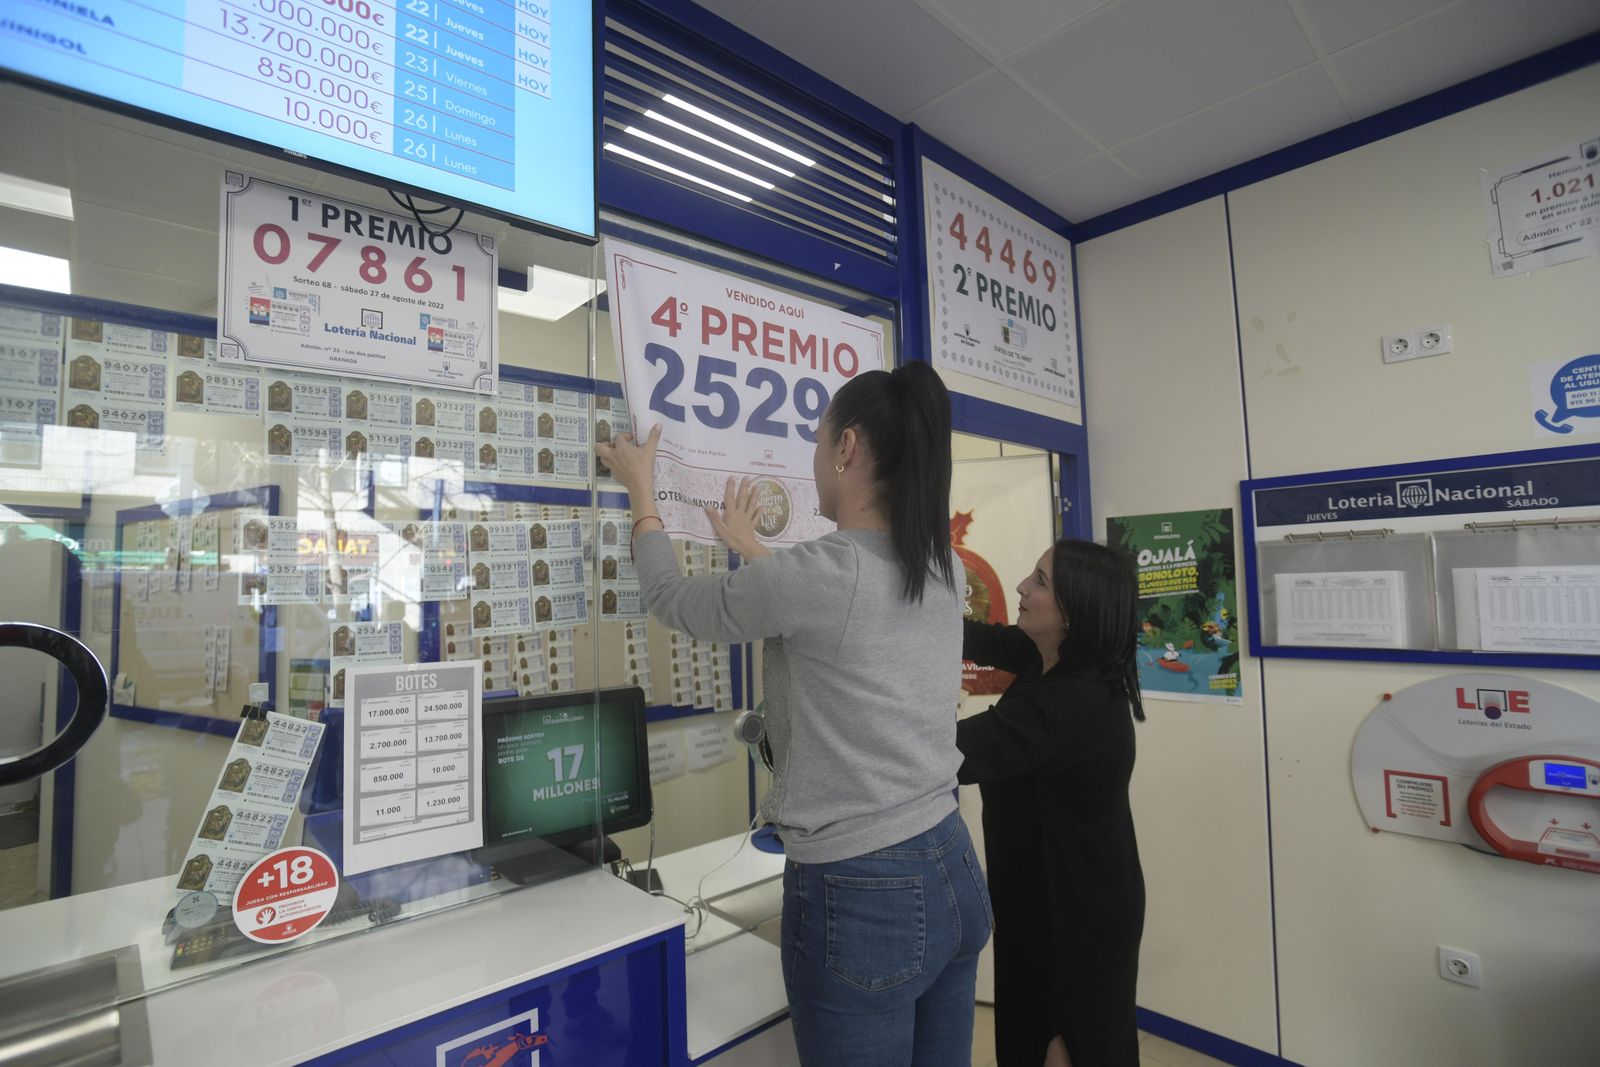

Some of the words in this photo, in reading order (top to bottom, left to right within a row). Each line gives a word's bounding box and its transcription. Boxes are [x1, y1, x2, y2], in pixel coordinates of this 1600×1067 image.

[518, 0, 548, 18] HOY
[405, 0, 429, 17] 22
[446, 18, 484, 40] Jueves
[518, 48, 548, 68] HOY
[518, 22, 548, 43] HOY
[221, 8, 383, 85] 13.700.000€
[404, 80, 428, 100] 25
[445, 100, 496, 125] Domingo
[405, 24, 429, 45] 22
[446, 44, 484, 67] Jueves
[518, 74, 548, 94] HOY
[405, 52, 428, 72] 23
[446, 72, 488, 96] Viernes
[258, 57, 383, 114] 850.000€
[404, 109, 428, 129] 26
[445, 128, 478, 146] Lunes
[284, 96, 382, 144] 10.000€
[404, 138, 428, 158] 26
[444, 156, 478, 174] Lunes
[1556, 206, 1577, 216] este
[322, 203, 452, 255] PREMIO
[253, 223, 465, 302] 07861
[950, 212, 1056, 292] 44469
[293, 275, 320, 287] Sorteo
[341, 284, 368, 295] sábado
[392, 295, 416, 304] agosto
[418, 298, 426, 306] de
[428, 301, 444, 310] 2022
[726, 288, 776, 311] VENDIDO
[778, 303, 805, 319] AQUÍ
[976, 272, 1056, 332] PREMIO
[324, 323, 366, 338] Lotería
[370, 329, 416, 346] Nacional
[650, 296, 688, 338] 4º
[701, 304, 859, 378] PREMIO
[329, 356, 358, 364] GRANADA
[206, 375, 244, 387] 98515
[294, 385, 328, 395] 49594
[644, 342, 831, 444] 2529
[294, 428, 328, 437] 49594
[1436, 480, 1534, 503] Nacional
[1306, 512, 1338, 522] JUEVES
[1506, 496, 1559, 508] SÁBADO
[270, 522, 298, 530] 5357
[1136, 539, 1196, 566] OJALÁ
[269, 565, 298, 574] 5357
[1138, 566, 1199, 582] BONOLOTO,
[395, 673, 438, 692] BOTES
[368, 707, 410, 718] 17.000.000
[424, 702, 463, 712] 24.500.000
[273, 720, 308, 733] 44822
[1490, 720, 1502, 728] del
[1504, 721, 1532, 730] Estado
[370, 739, 408, 750] 2.700.000
[424, 732, 463, 744] 13.700.000
[256, 764, 290, 778] 44822
[373, 772, 404, 783] 850.000
[432, 764, 456, 774] 10.000
[548, 744, 584, 783] 17
[532, 779, 600, 802] MILLONES
[236, 810, 274, 824] 44822
[376, 806, 401, 816] 11.000
[426, 796, 461, 807] 1.230.000
[258, 856, 314, 889] +18
[246, 897, 264, 906] JUEGA
[279, 881, 328, 898] RESPONSABILIDAD
